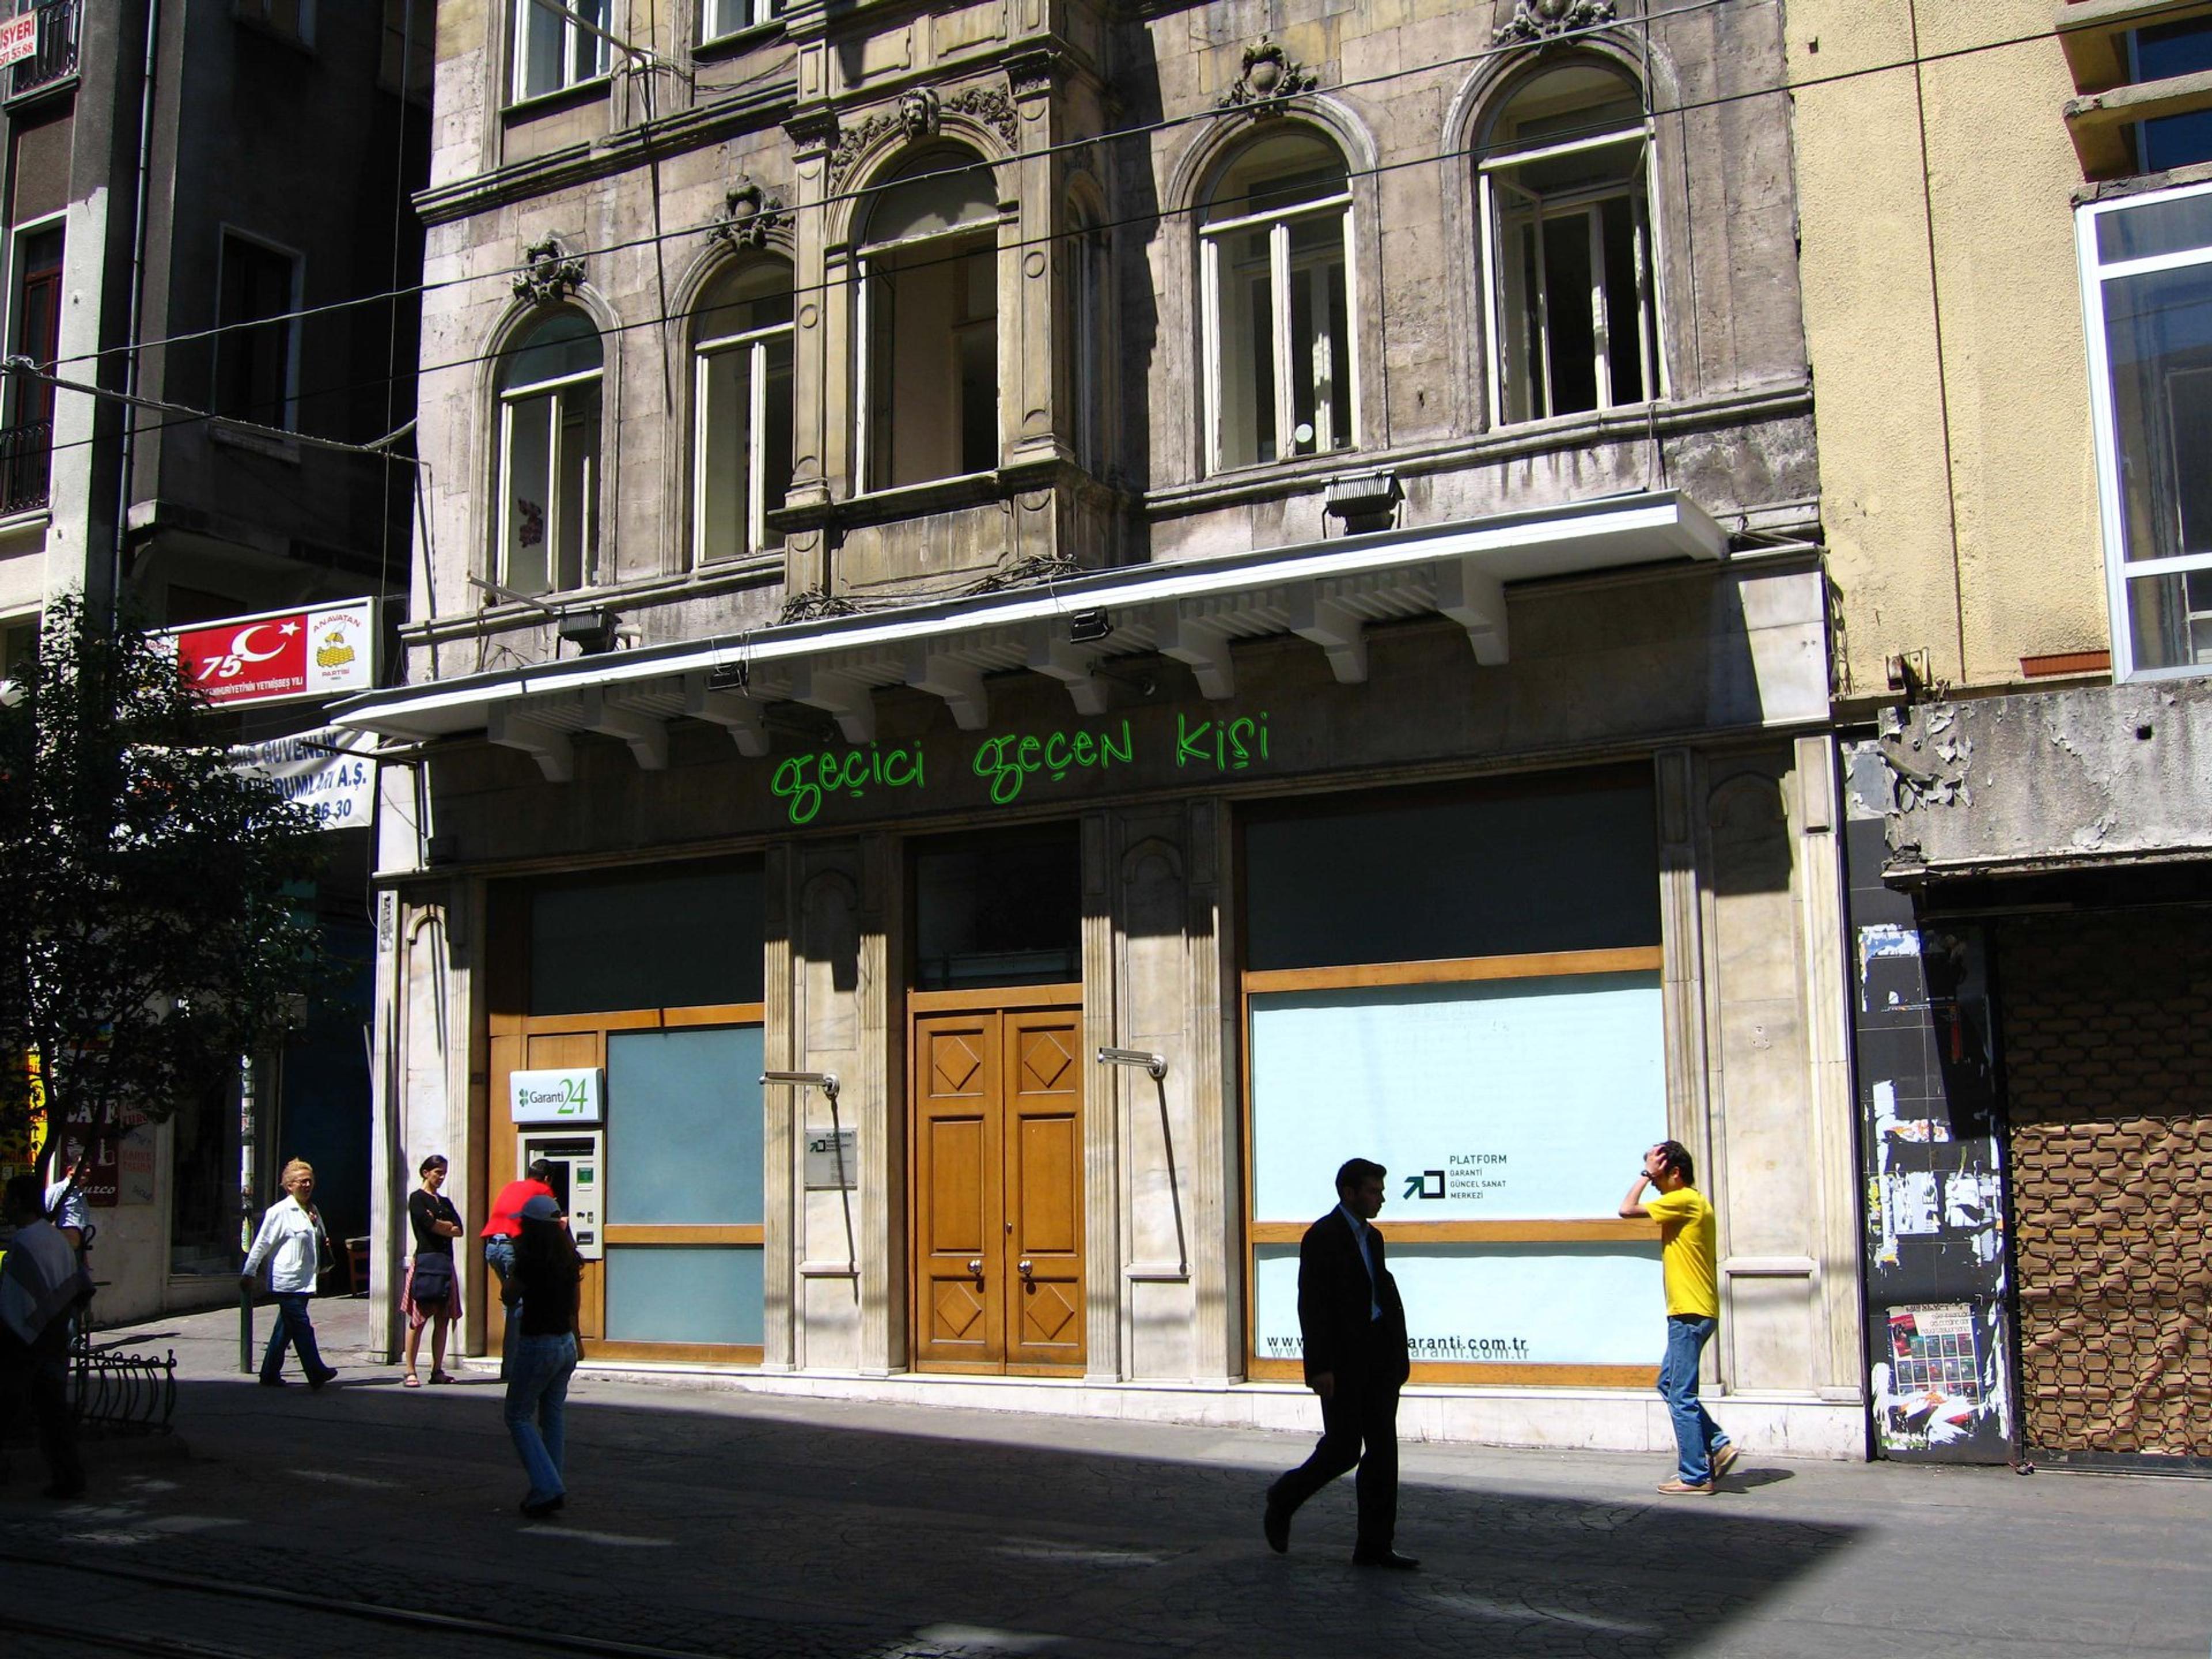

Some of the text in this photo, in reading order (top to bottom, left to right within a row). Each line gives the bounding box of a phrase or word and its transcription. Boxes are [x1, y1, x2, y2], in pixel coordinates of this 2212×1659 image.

[314, 615, 360, 632] ANAVATAN
[336, 798, 351, 817] 30
[530, 1078, 588, 1113] Garanti 24
[1450, 1154, 1507, 1164] PLATFORM
[1450, 1168, 1483, 1176] GARANTİ
[1450, 1179, 1479, 1187] GÜNCEL
[1450, 1190, 1483, 1199] MERKEZİ
